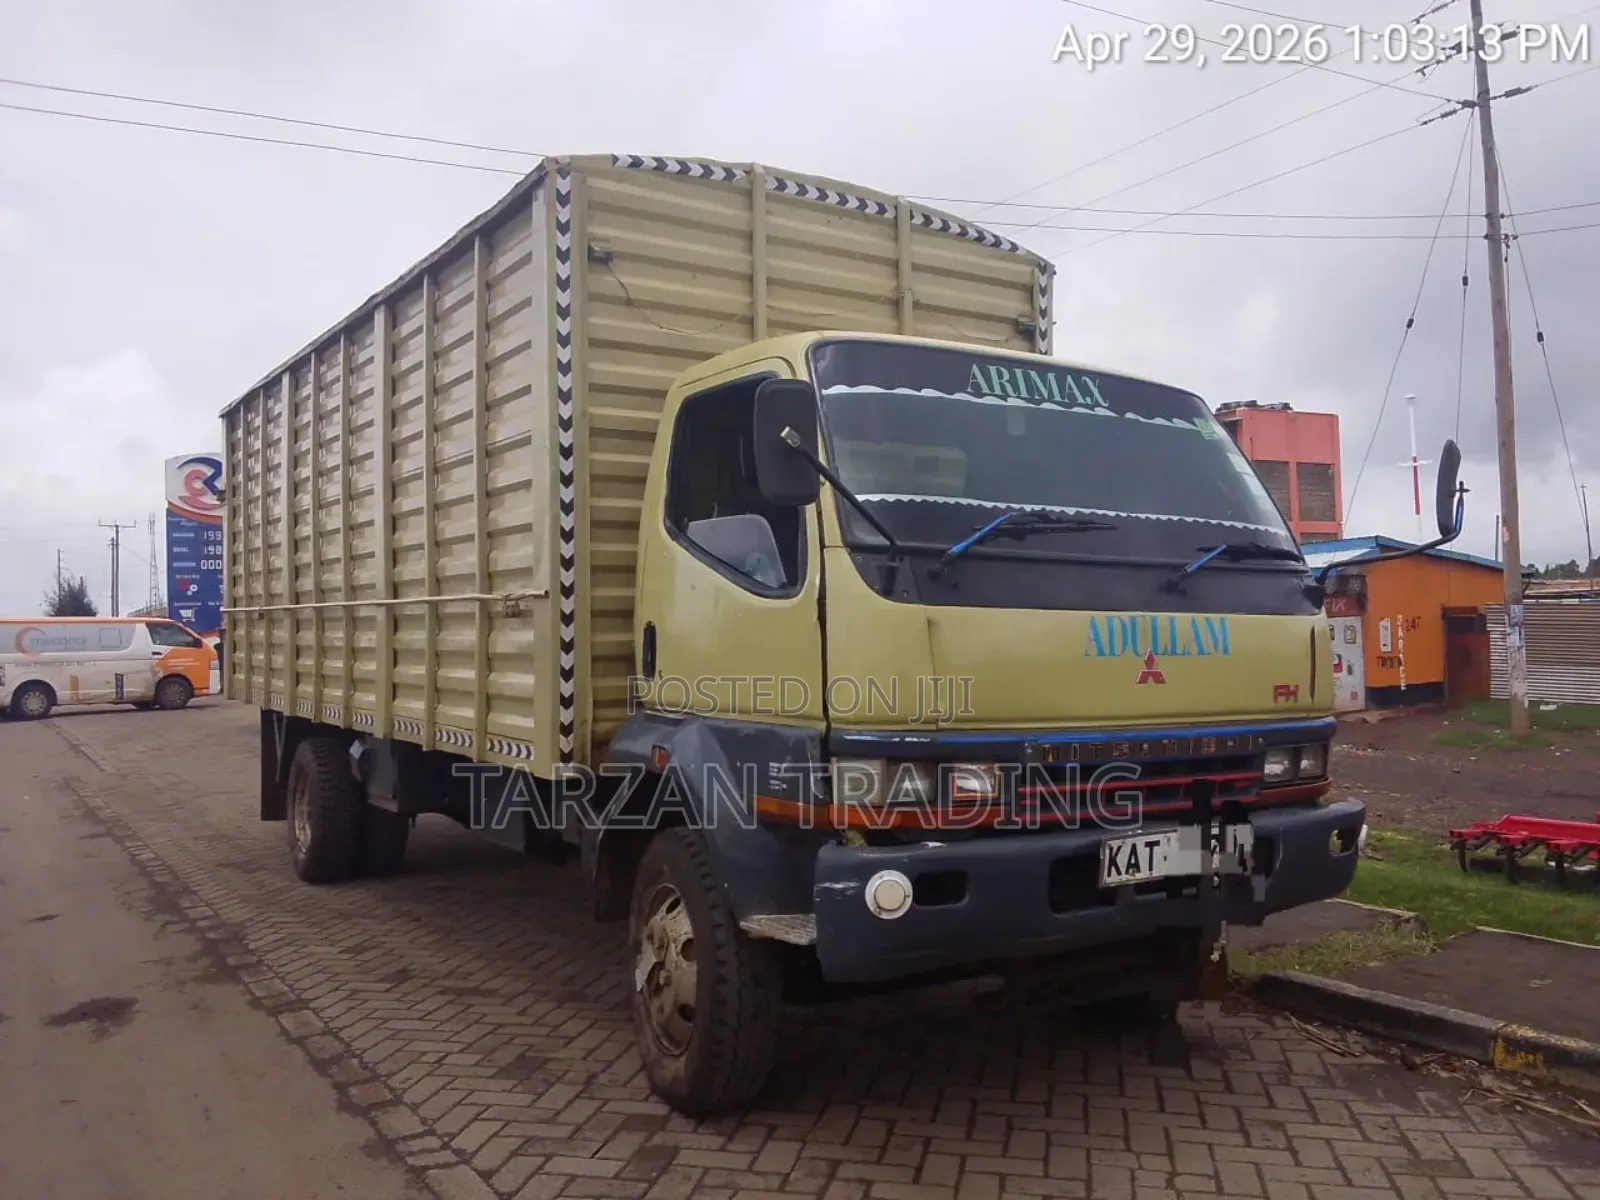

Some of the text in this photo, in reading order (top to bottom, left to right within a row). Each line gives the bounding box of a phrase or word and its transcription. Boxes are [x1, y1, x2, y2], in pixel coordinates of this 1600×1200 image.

[967, 363, 1109, 407] ARIMAX
[1083, 614, 1231, 657] ADULLAM
[1106, 839, 1161, 878] KAT
